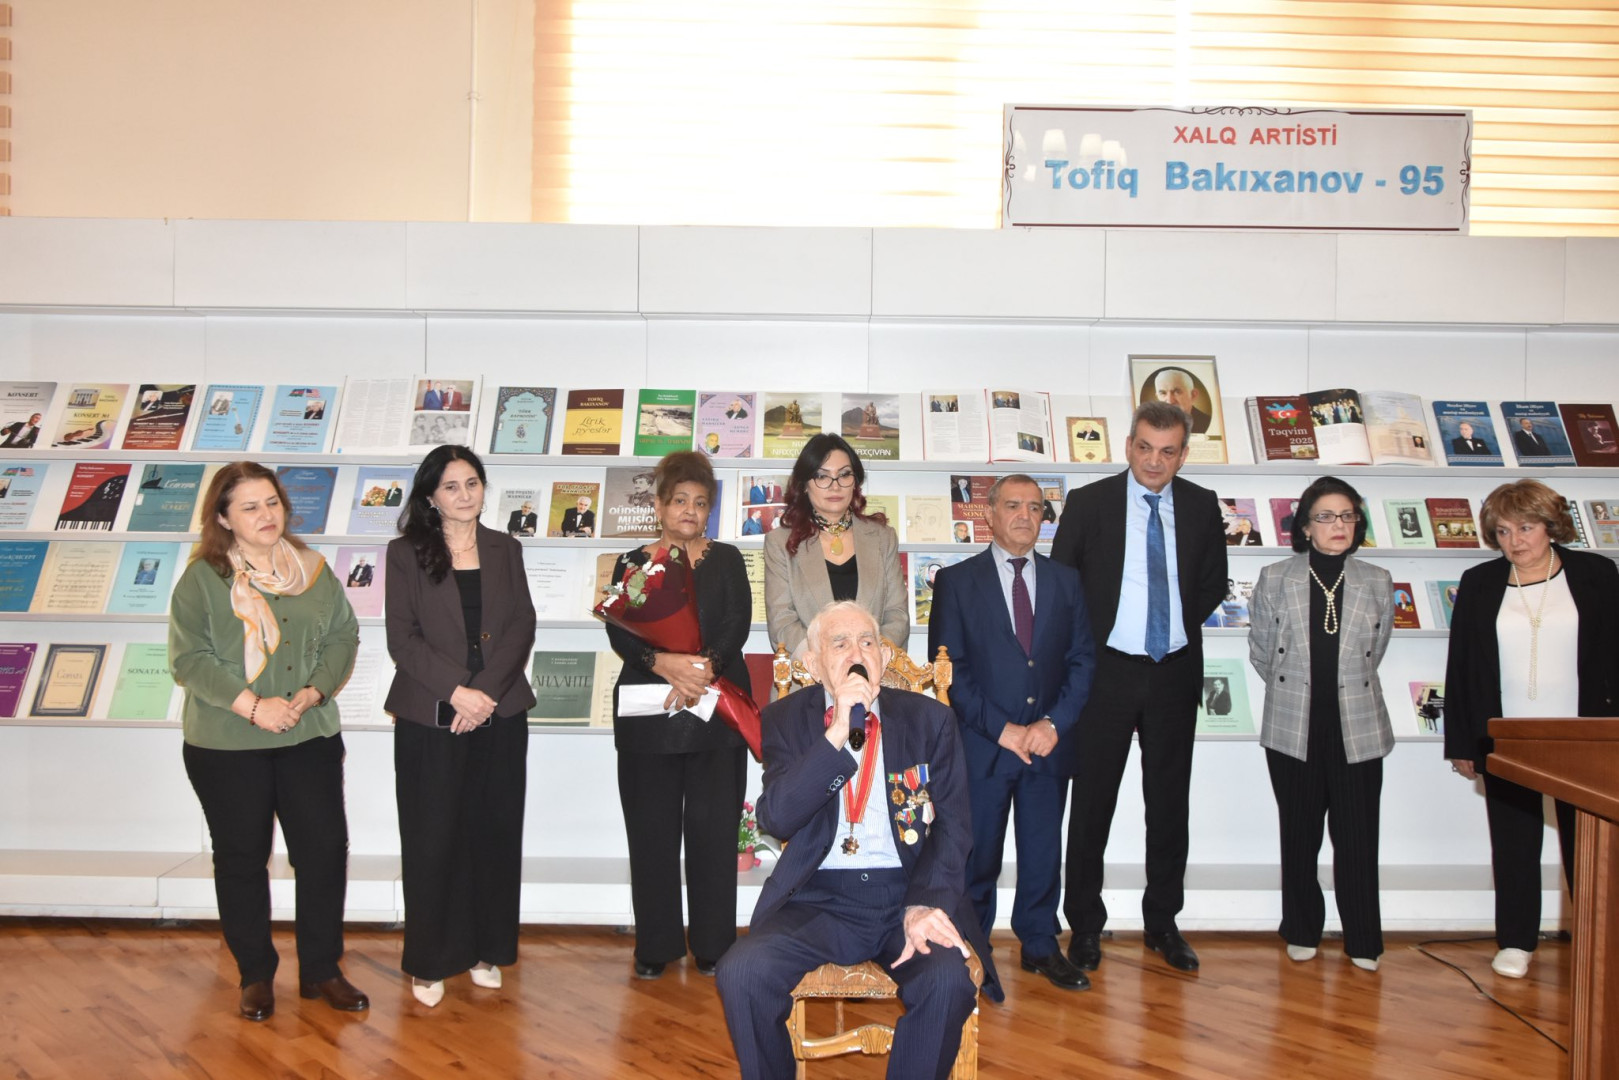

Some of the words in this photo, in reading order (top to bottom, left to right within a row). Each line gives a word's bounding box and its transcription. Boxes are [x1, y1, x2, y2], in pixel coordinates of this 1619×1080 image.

[1173, 126, 1237, 145] XALQ
[1249, 124, 1336, 146] ARTİSTİ
[1045, 160, 1138, 198] Tofiq
[1166, 161, 1363, 194] Bakıxanov
[1400, 164, 1445, 196] 95
[1268, 427, 1308, 437] Təqvim
[1290, 437, 1314, 446] 2025
